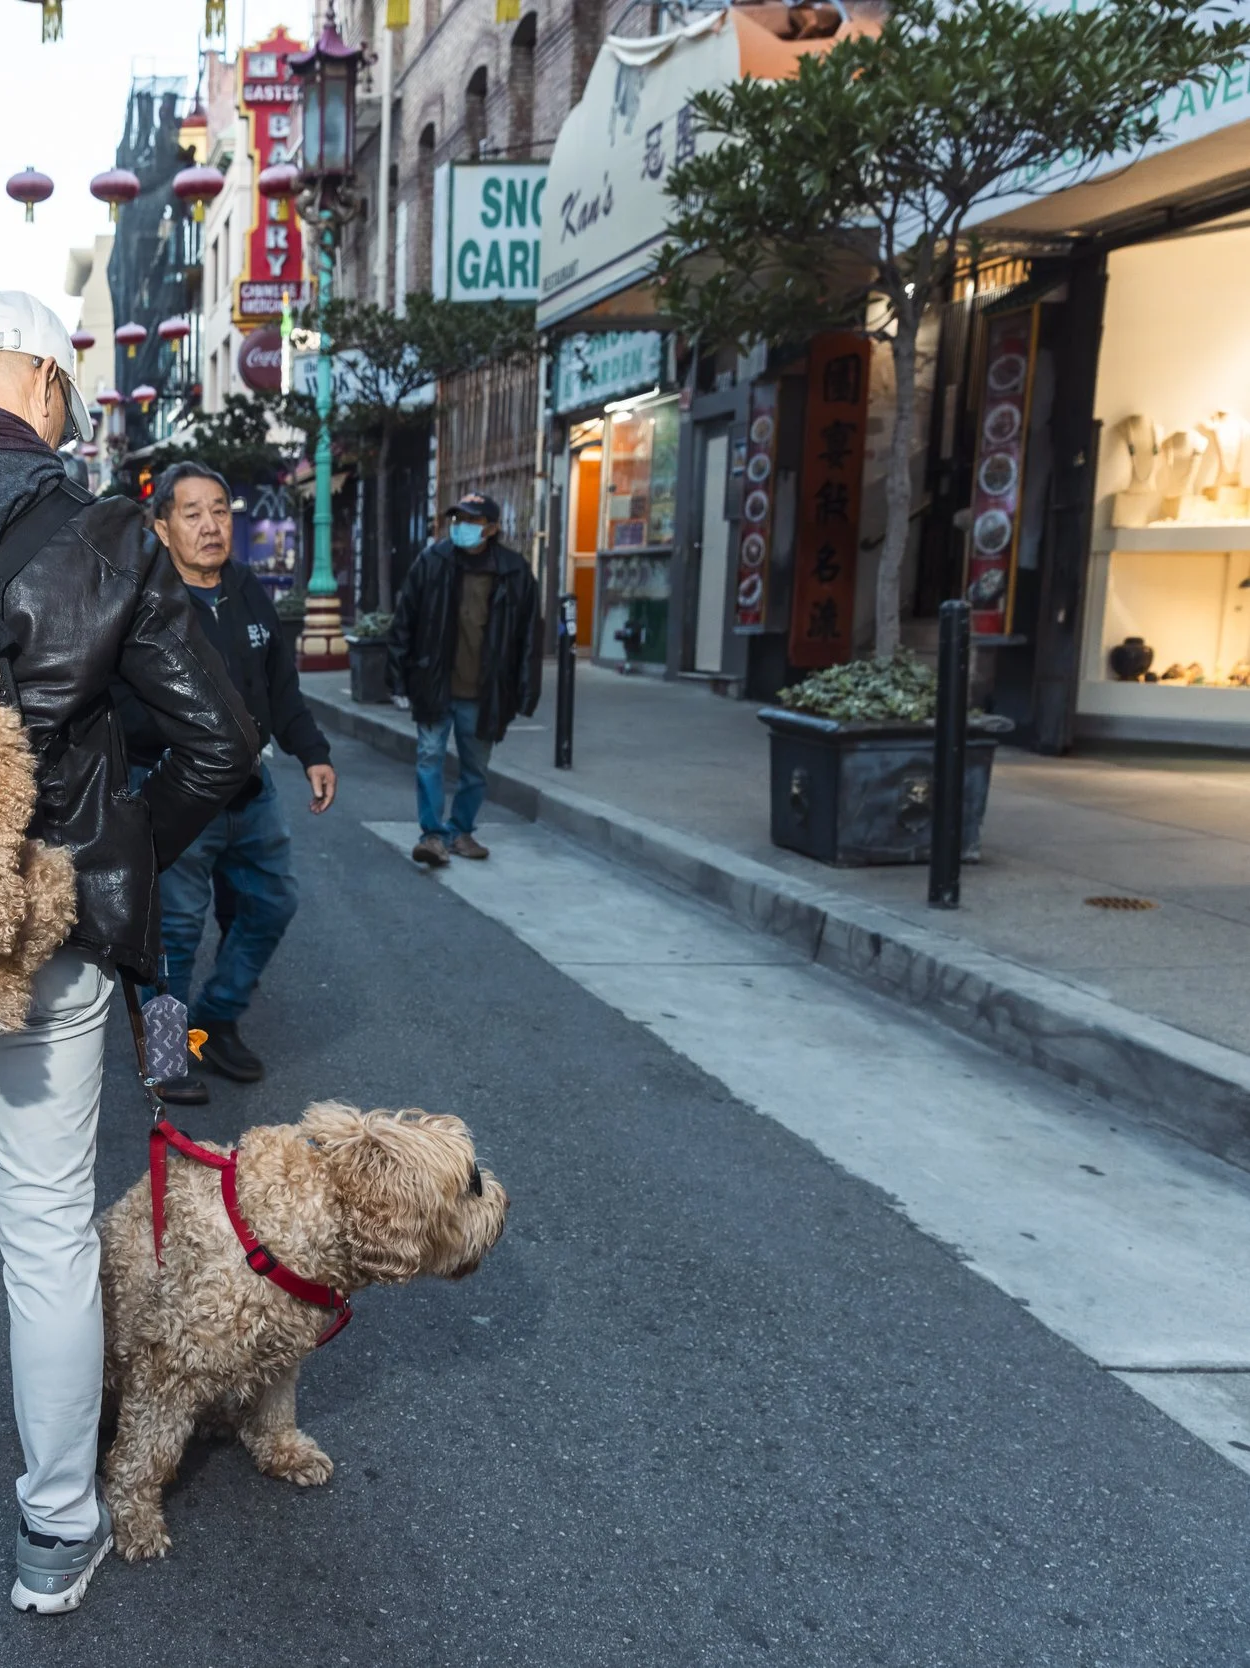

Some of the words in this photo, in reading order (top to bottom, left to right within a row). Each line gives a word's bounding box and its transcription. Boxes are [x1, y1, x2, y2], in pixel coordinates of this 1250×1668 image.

[1173, 55, 1250, 124] AVE
[560, 170, 613, 244] Kan's
[457, 239, 540, 290] GAR
